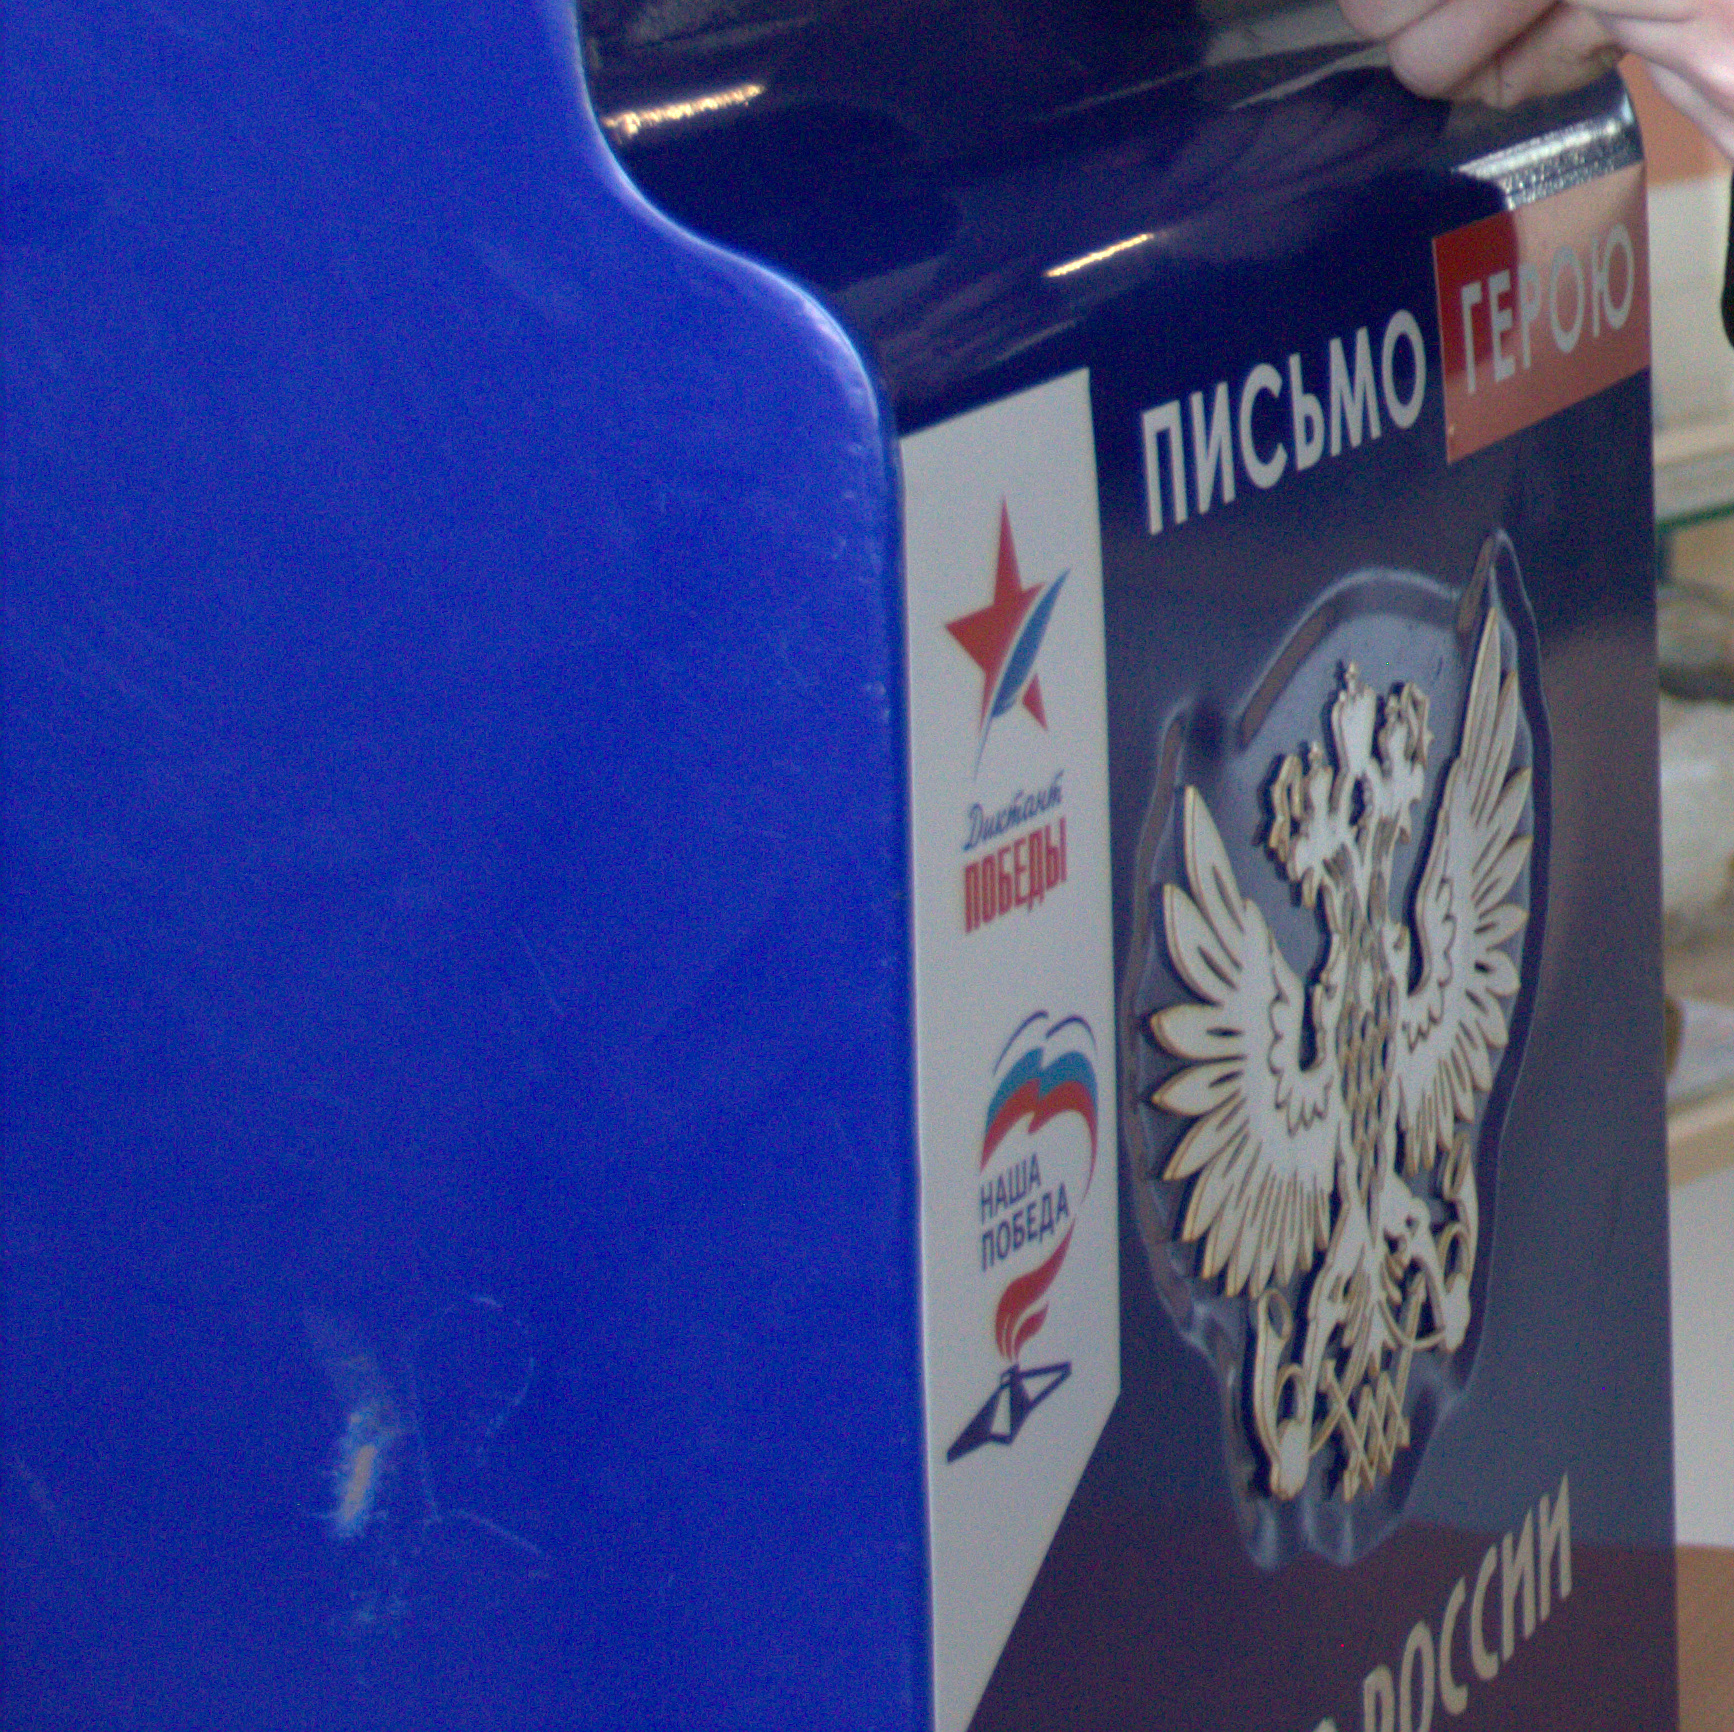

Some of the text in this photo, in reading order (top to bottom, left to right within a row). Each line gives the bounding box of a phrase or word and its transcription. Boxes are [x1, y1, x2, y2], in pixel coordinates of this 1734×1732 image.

[1141, 222, 1635, 535] ПИСЬМО ГЕРОЮ
[963, 816, 1067, 934] ПОБЕДЫ
[980, 1152, 1041, 1224] НАША
[981, 1182, 1069, 1273] ПОБЕДА
[1363, 1471, 1572, 1732] РОССИИ
